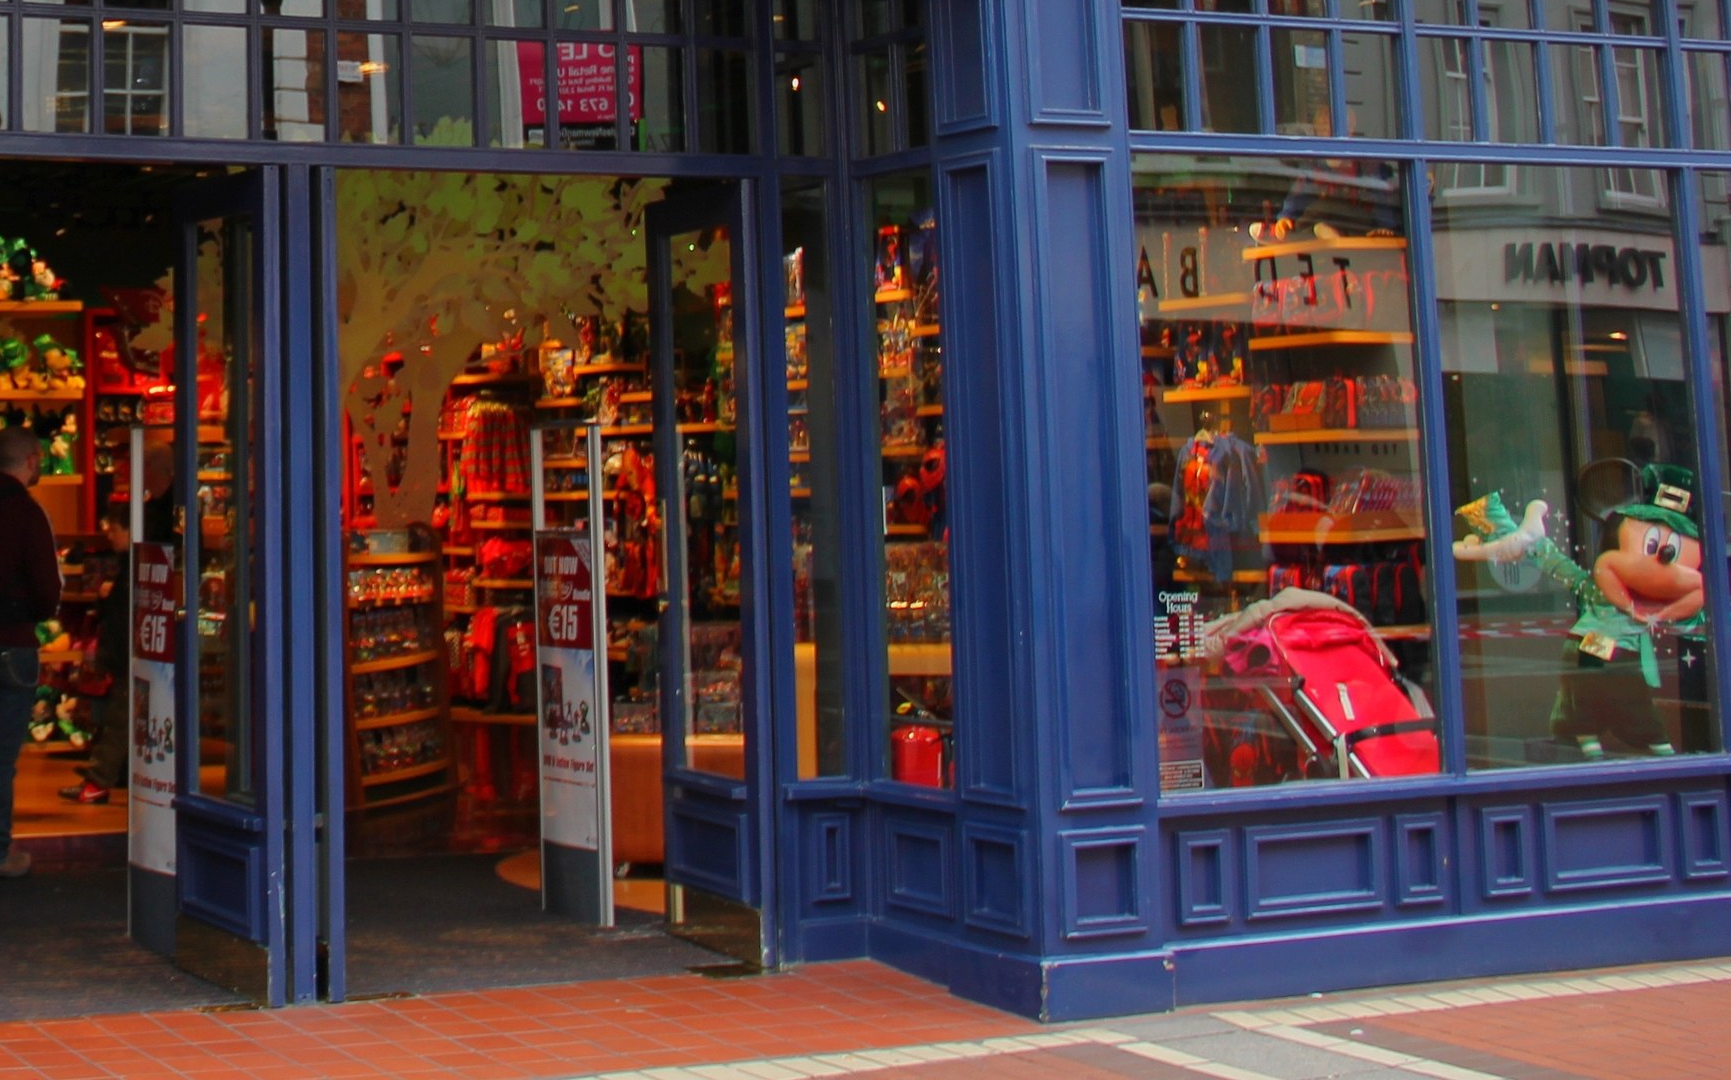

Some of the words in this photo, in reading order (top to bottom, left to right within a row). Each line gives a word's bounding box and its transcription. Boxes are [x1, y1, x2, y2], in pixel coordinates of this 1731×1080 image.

[1158, 591, 1198, 605] Opening
[1166, 601, 1193, 614] Hours
[140, 615, 168, 654] €15
[548, 604, 579, 641] €15
